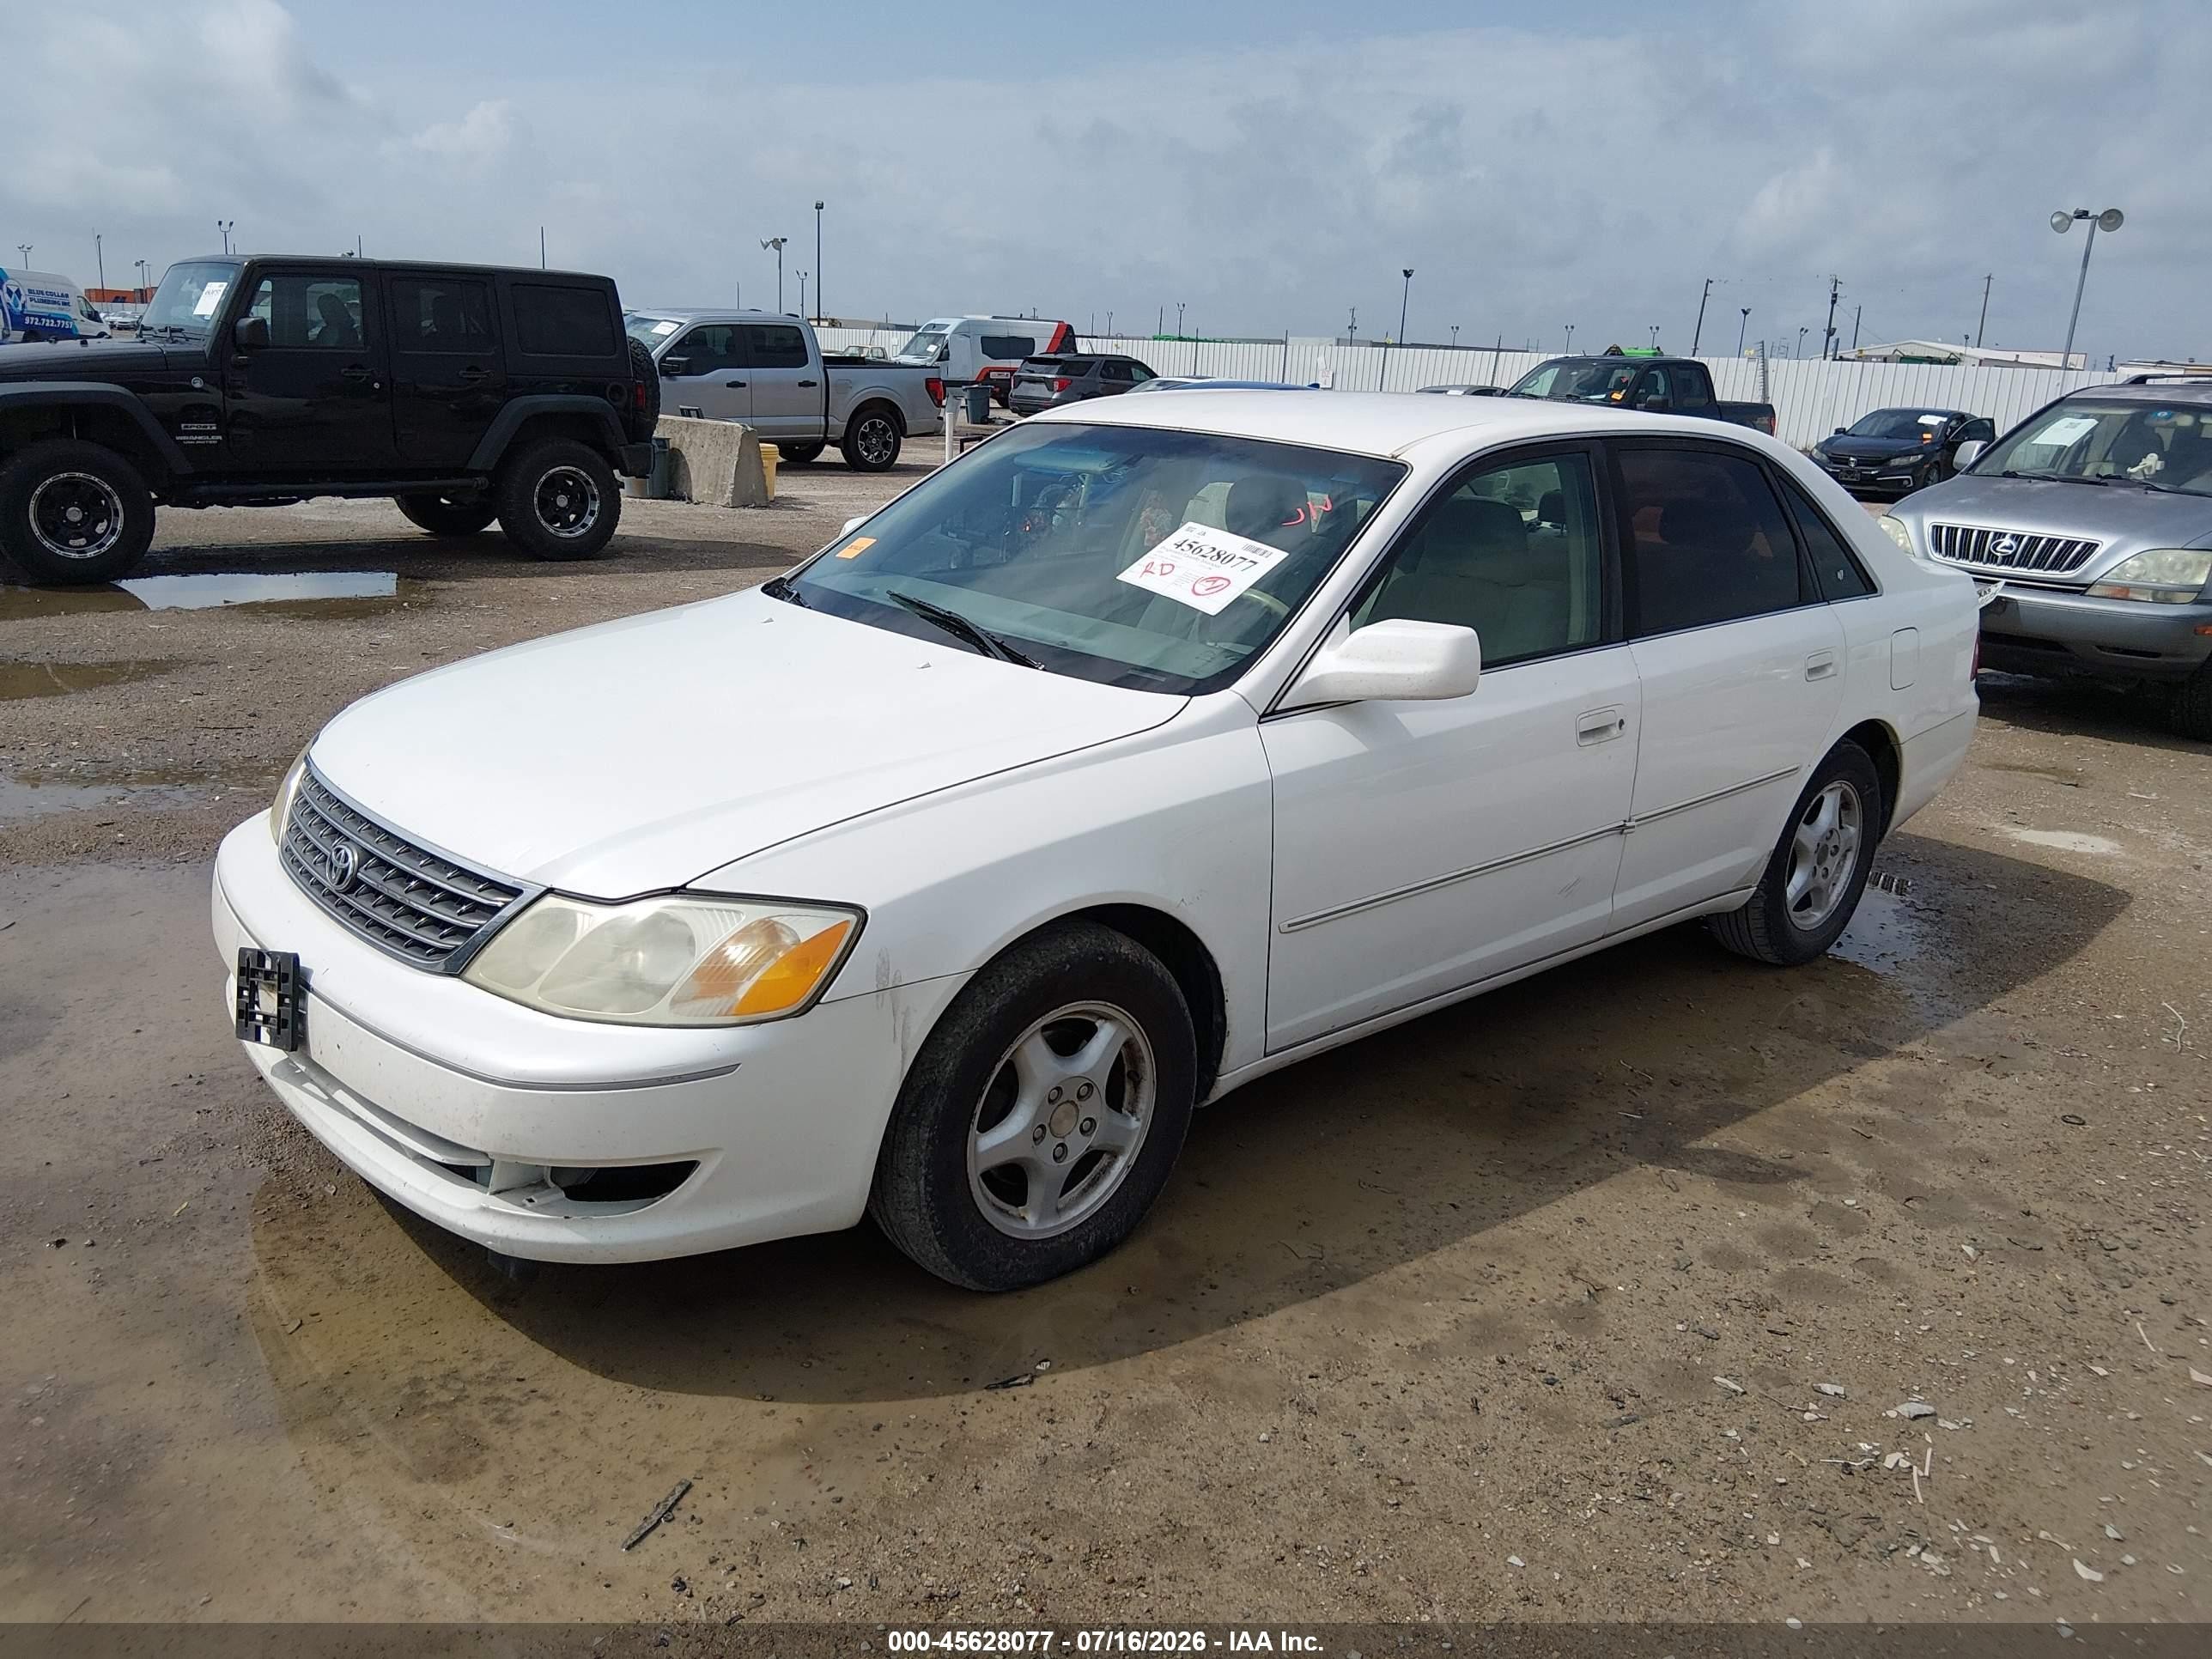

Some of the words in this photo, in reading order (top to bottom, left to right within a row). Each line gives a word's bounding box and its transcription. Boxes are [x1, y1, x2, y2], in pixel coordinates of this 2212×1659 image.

[46, 290, 70, 299] COLLAR
[25, 316, 73, 329] 972.722.7757
[1173, 538, 1259, 572] 45628077
